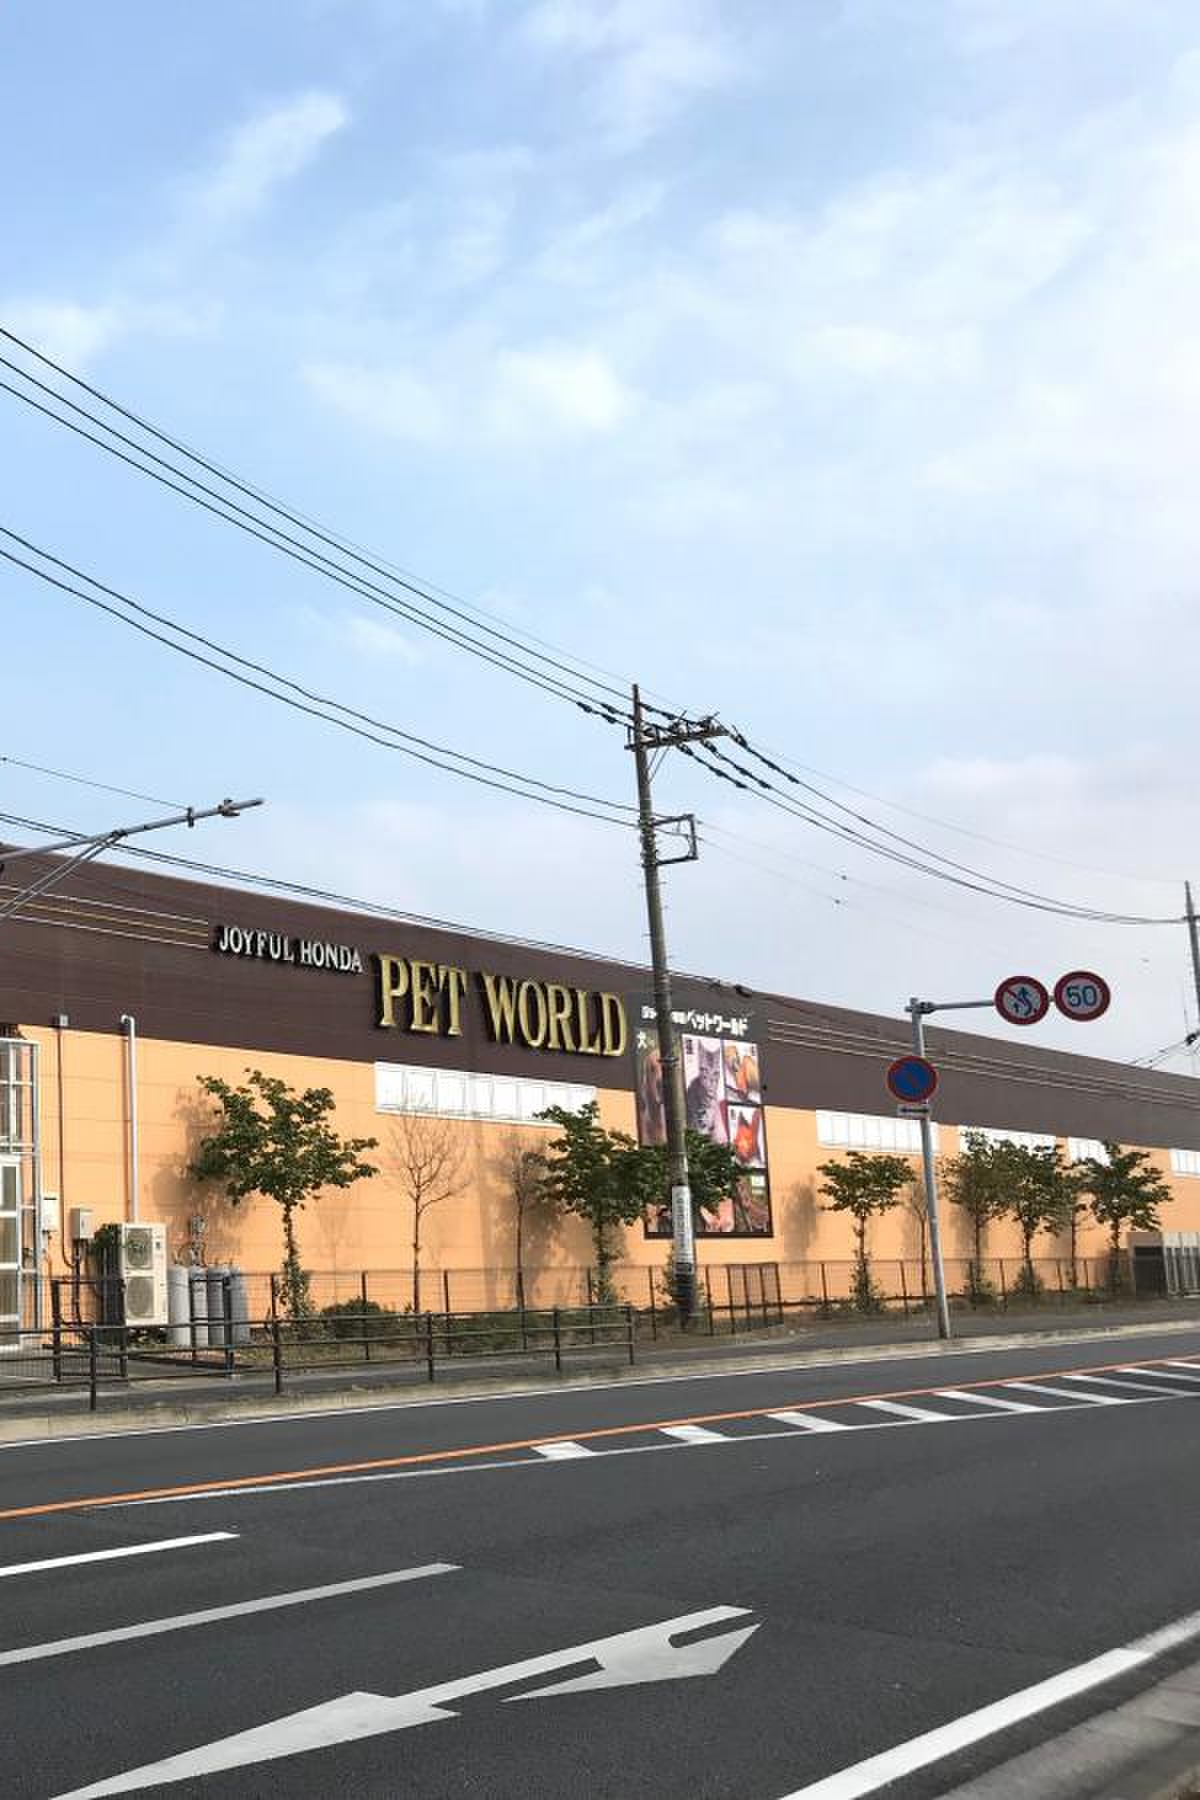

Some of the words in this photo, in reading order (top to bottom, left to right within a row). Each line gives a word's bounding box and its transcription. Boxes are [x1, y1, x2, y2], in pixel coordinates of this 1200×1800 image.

[219, 926, 294, 962] JOYFUL
[300, 938, 363, 974] HONDA
[379, 953, 468, 1037] PET
[481, 970, 628, 1058] WORLD
[1066, 985, 1097, 1007] 50
